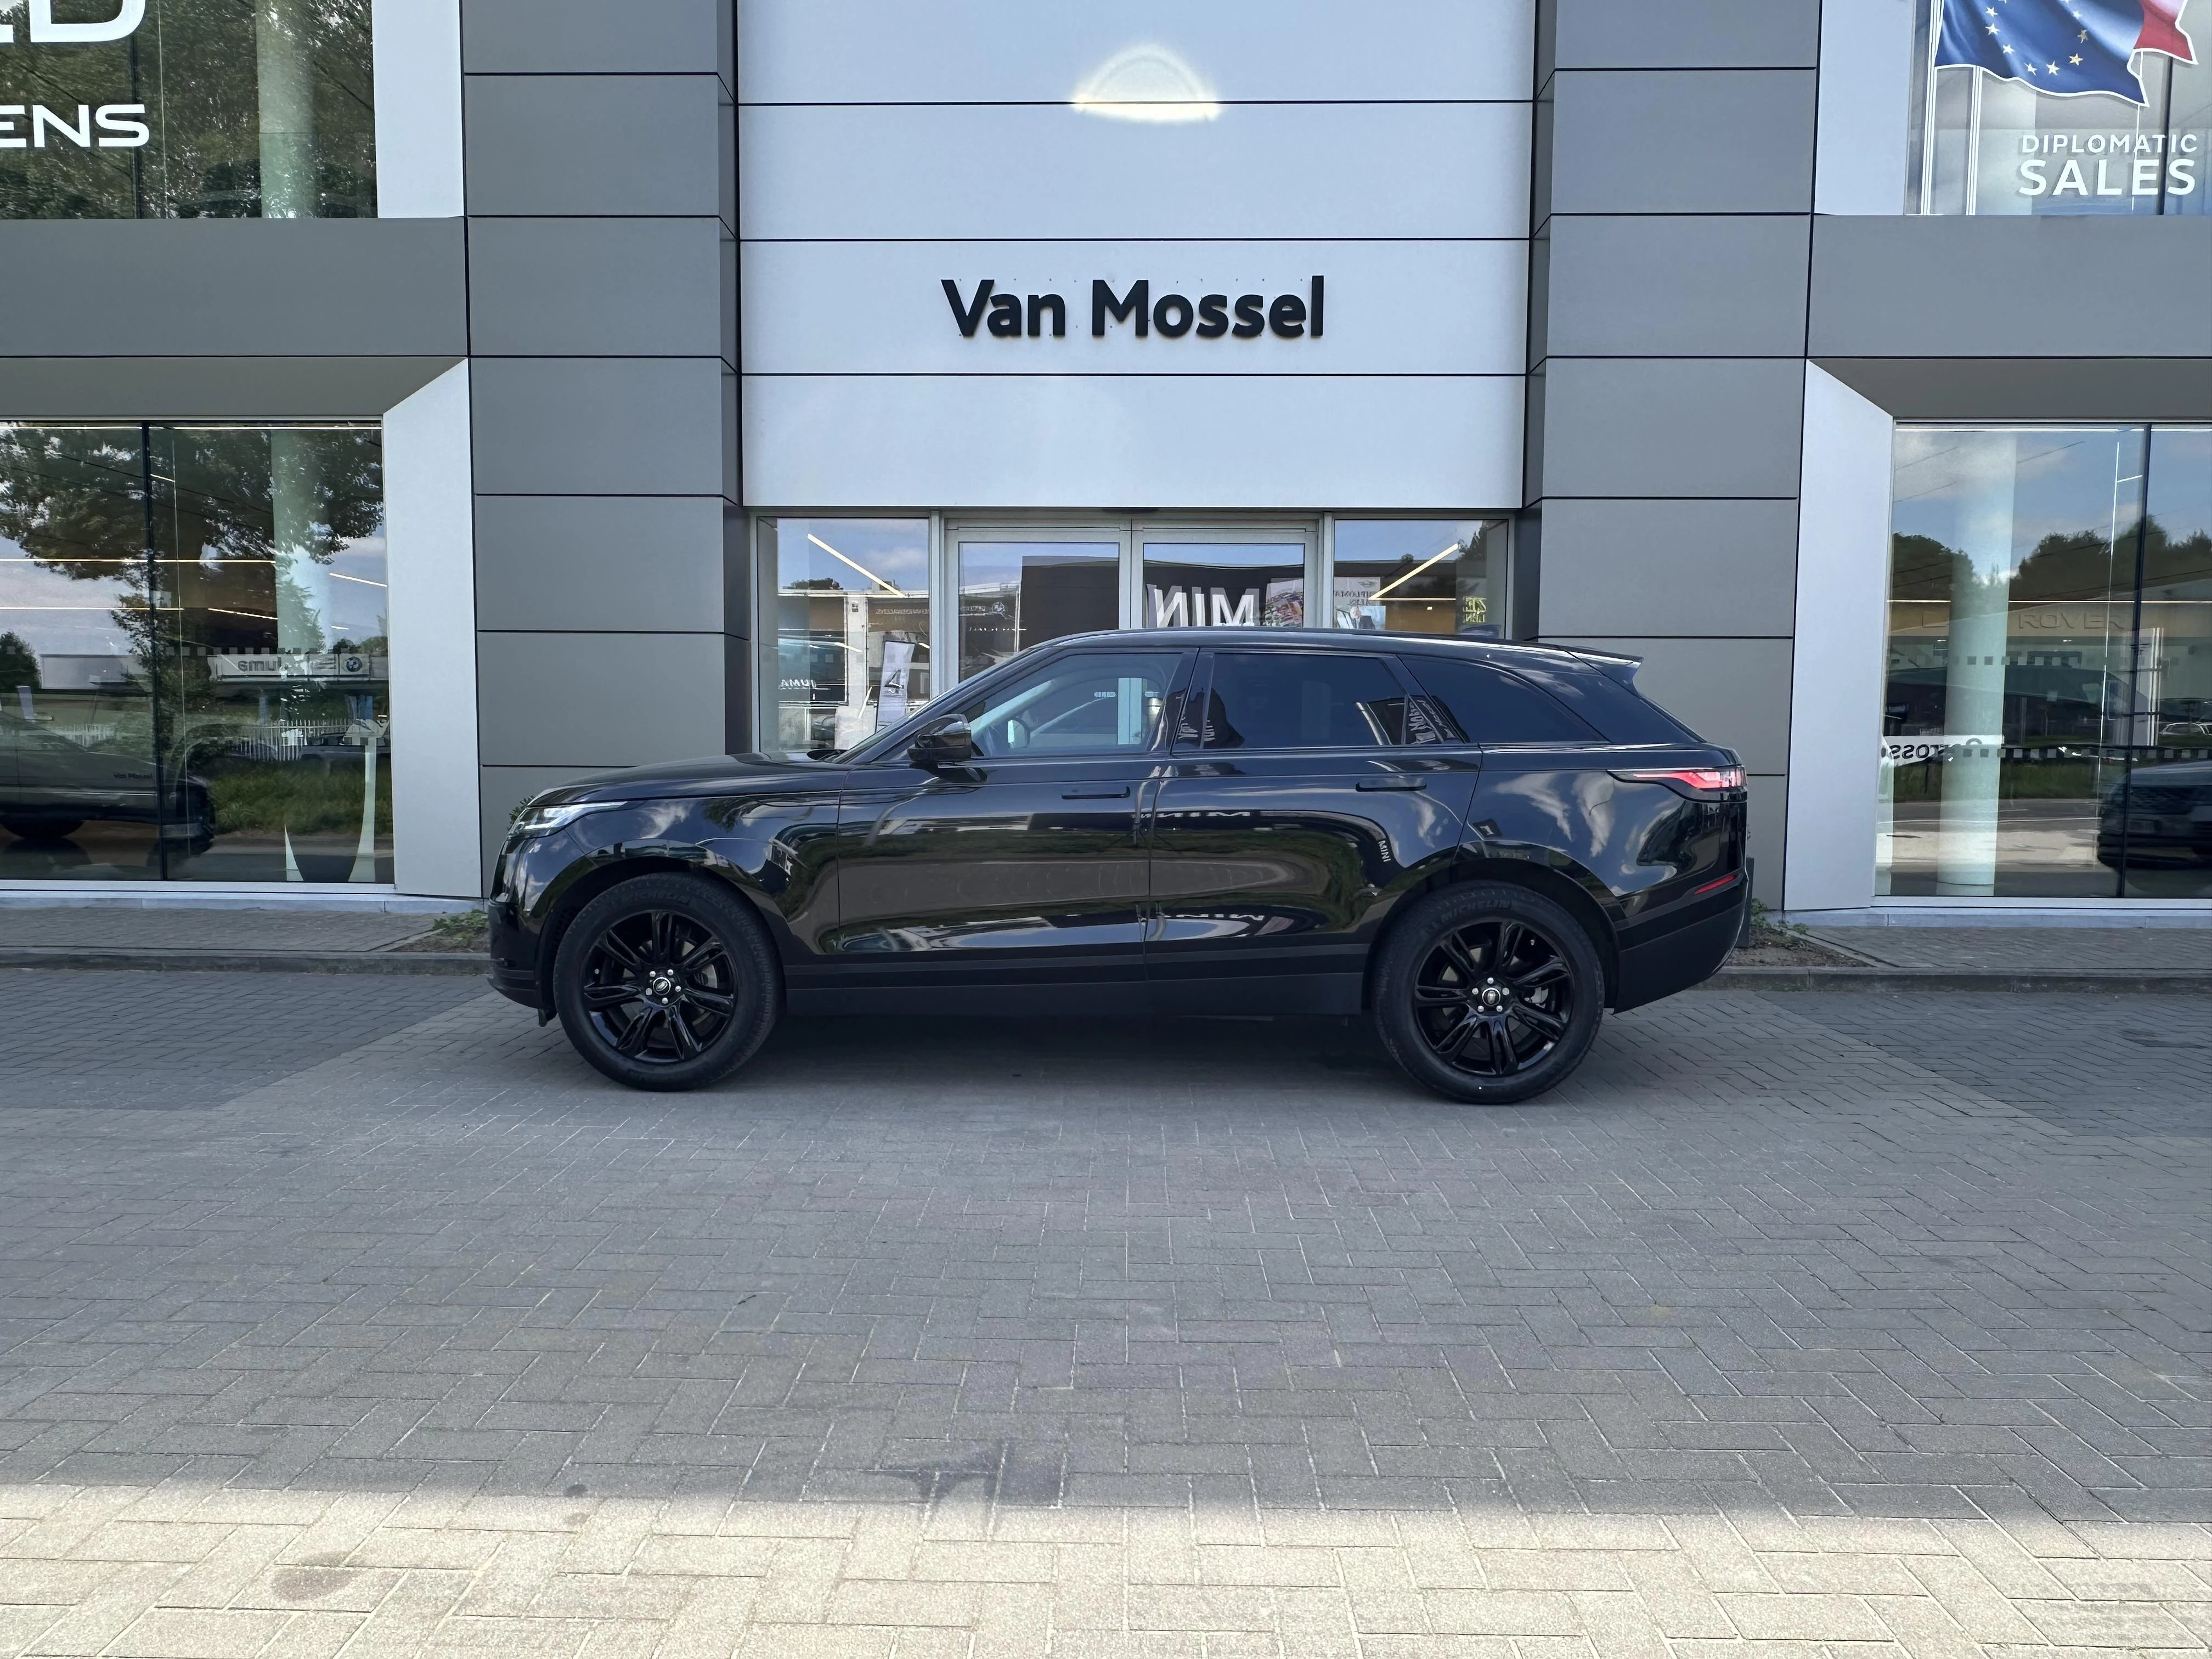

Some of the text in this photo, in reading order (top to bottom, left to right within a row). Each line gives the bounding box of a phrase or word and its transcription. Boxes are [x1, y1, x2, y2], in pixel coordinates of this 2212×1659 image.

[2022, 134, 2198, 154] DIPLOMATIC
[2018, 159, 2196, 196] SALES
[940, 275, 1324, 337] Van Mossel
